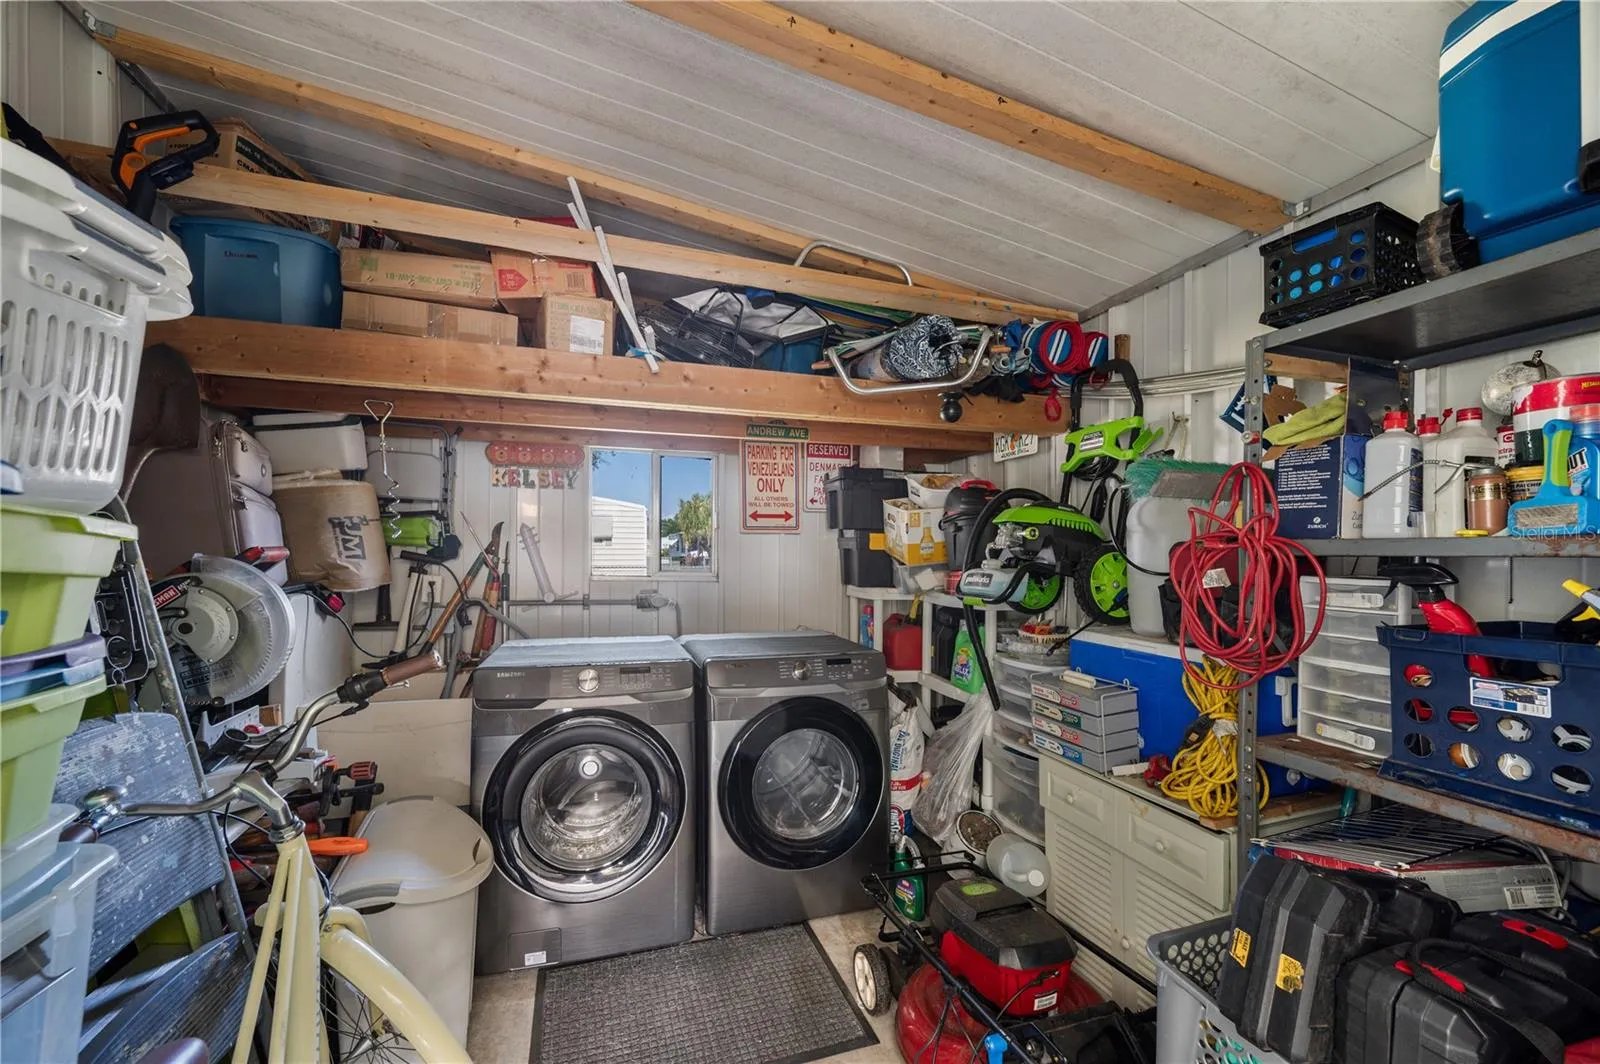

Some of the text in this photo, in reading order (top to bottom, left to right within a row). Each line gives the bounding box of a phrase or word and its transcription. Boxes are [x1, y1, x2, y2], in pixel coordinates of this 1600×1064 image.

[747, 425, 786, 437] ANDREW
[747, 445, 794, 461] PARKING FOR
[808, 444, 850, 456] RESERVED
[747, 462, 795, 478] VENEZUELANS
[492, 467, 579, 490] KELSEY
[756, 478, 785, 493] ONLY
